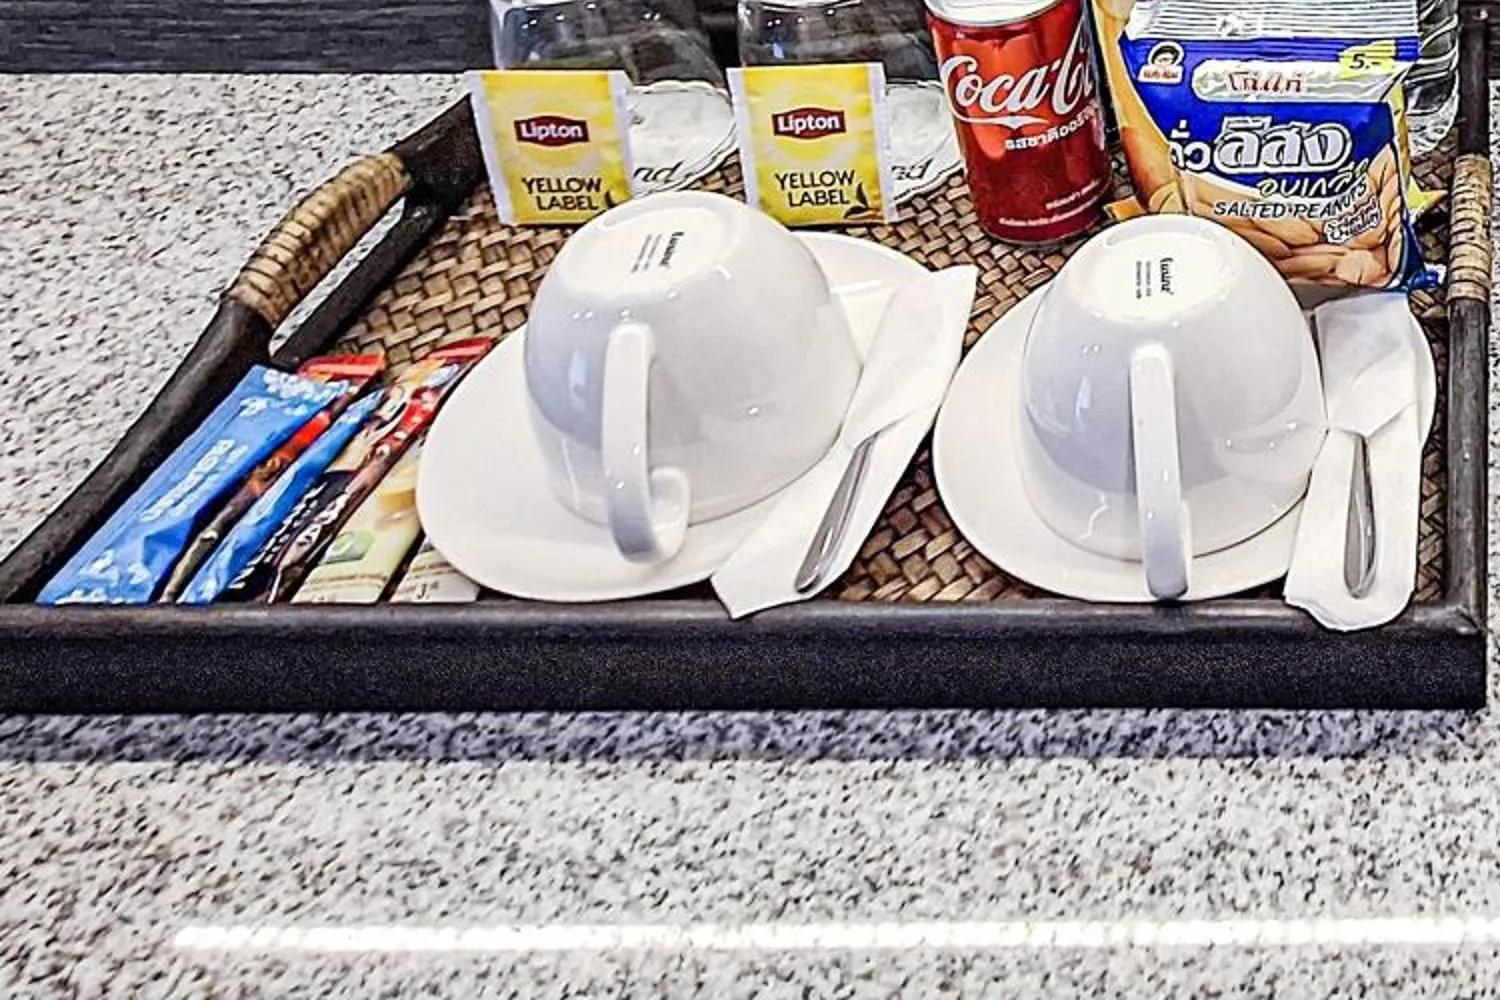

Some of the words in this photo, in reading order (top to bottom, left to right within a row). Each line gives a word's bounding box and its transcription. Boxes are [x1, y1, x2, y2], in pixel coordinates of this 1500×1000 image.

[520, 122, 583, 141] Lipton
[777, 115, 840, 134] Lipton
[522, 177, 602, 194] YELLOW
[775, 169, 855, 190] YELLOW
[535, 195, 599, 211] LABEL
[787, 189, 850, 207] LABEL
[1214, 201, 1287, 220] SALTED
